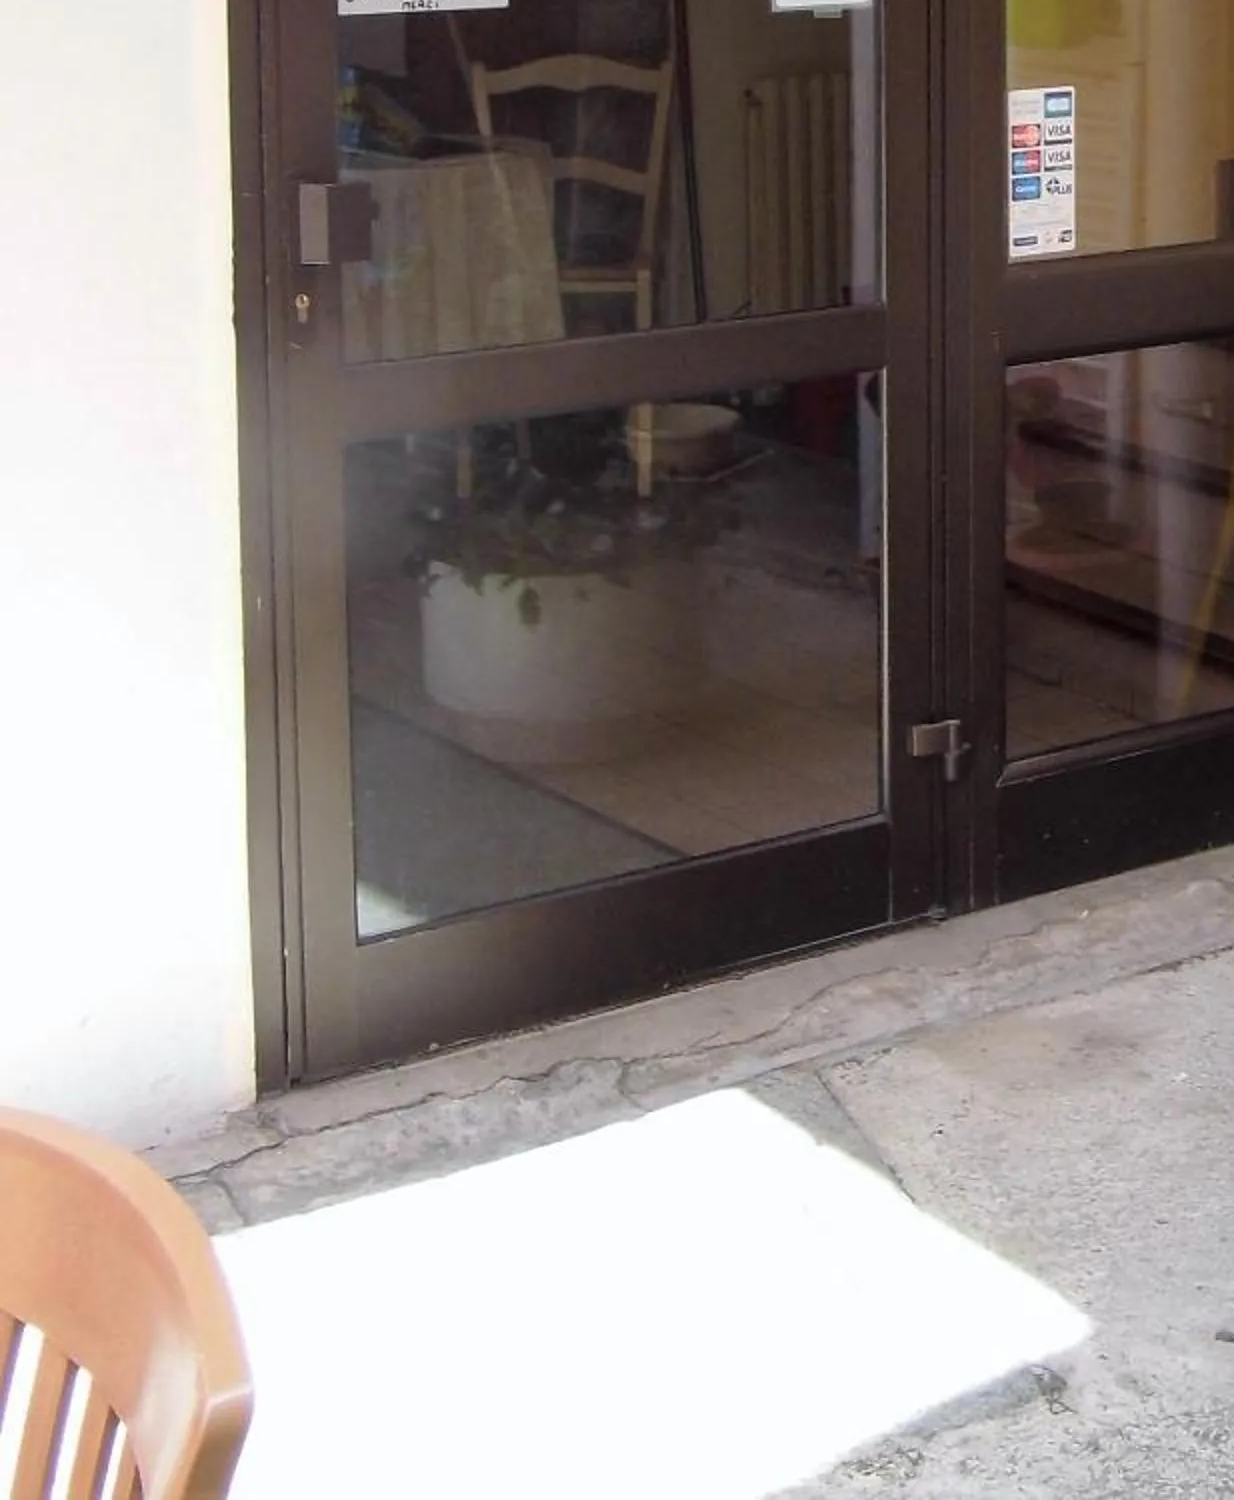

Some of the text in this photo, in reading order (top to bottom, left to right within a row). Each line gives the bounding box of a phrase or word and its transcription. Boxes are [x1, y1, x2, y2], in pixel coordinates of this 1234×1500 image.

[1048, 124, 1071, 138] VISA
[1048, 150, 1071, 164] VISA
[1052, 183, 1072, 196] PLUS
